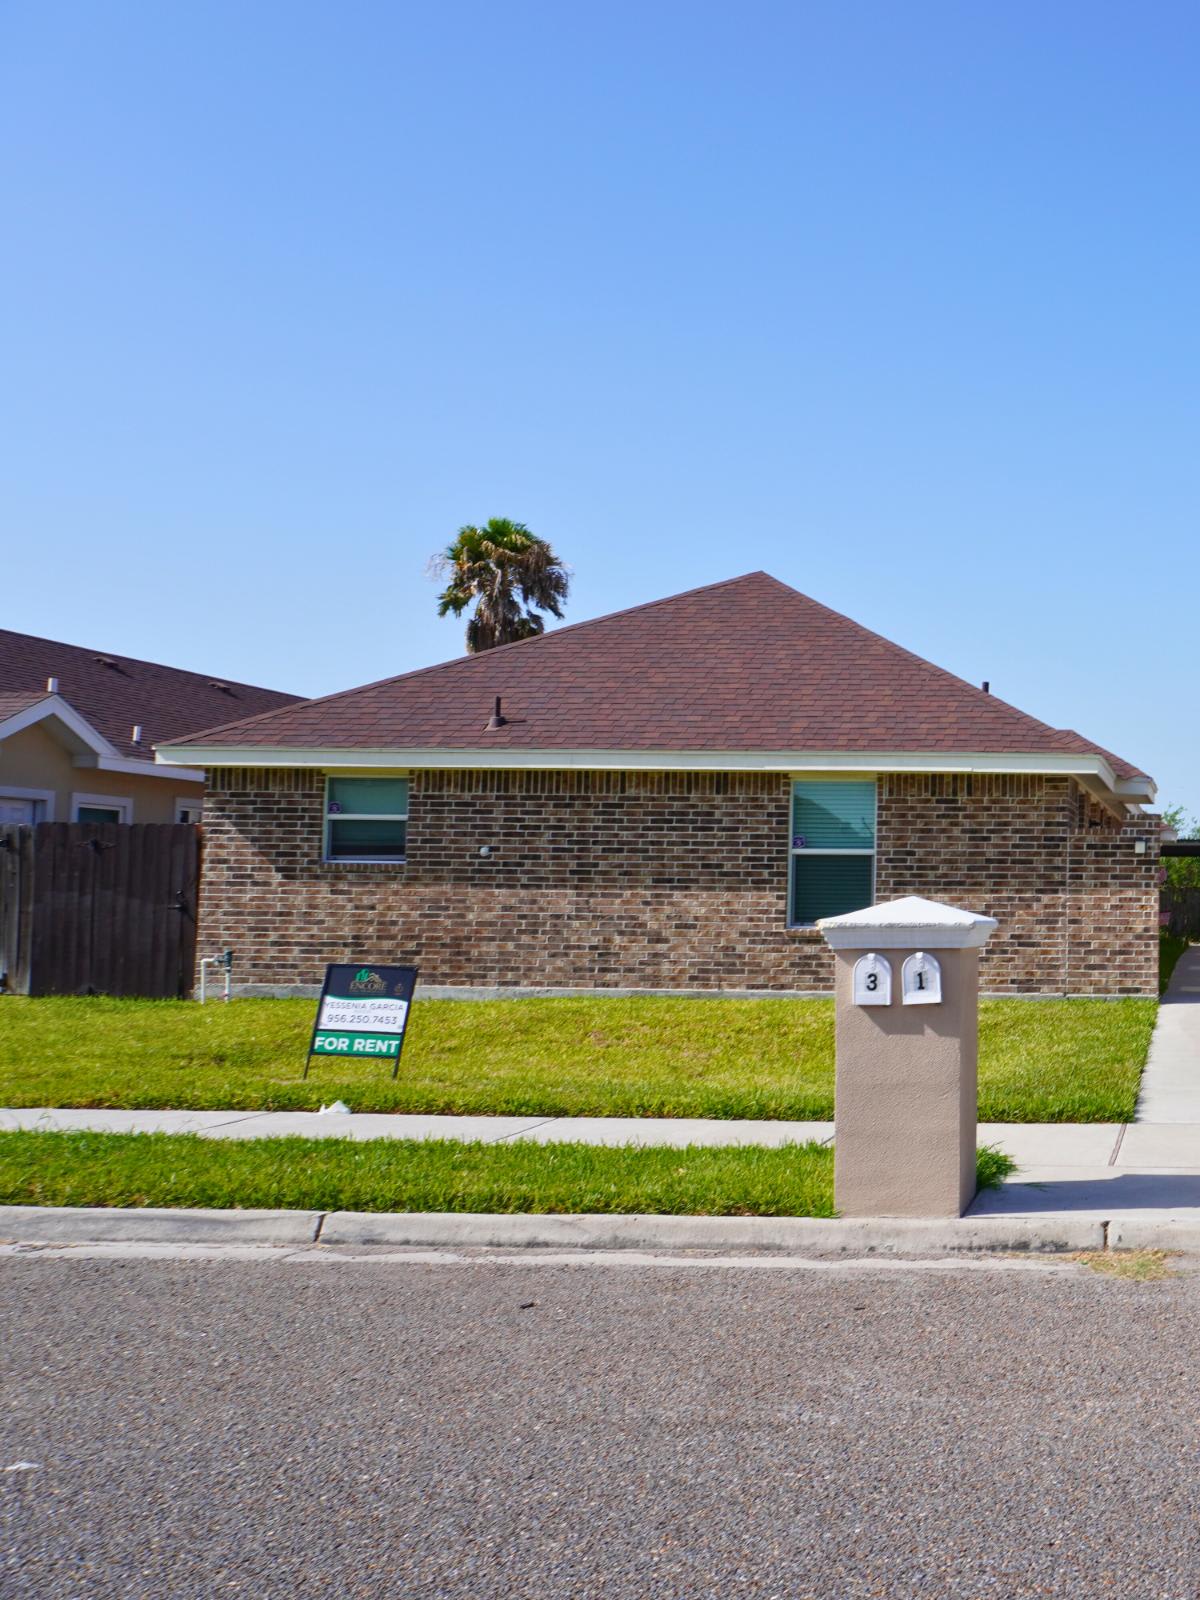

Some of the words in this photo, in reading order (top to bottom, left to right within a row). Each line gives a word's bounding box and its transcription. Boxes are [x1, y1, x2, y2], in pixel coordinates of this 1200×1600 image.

[350, 981, 387, 991] ENCORE
[866, 973, 877, 991] 3
[917, 972, 925, 990] 1
[325, 1001, 367, 1010] YESSENIA
[369, 1003, 404, 1011] GARCIA
[327, 1014, 398, 1025] 956.250.7453
[314, 1037, 350, 1050] FOR
[353, 1038, 400, 1053] RENT
